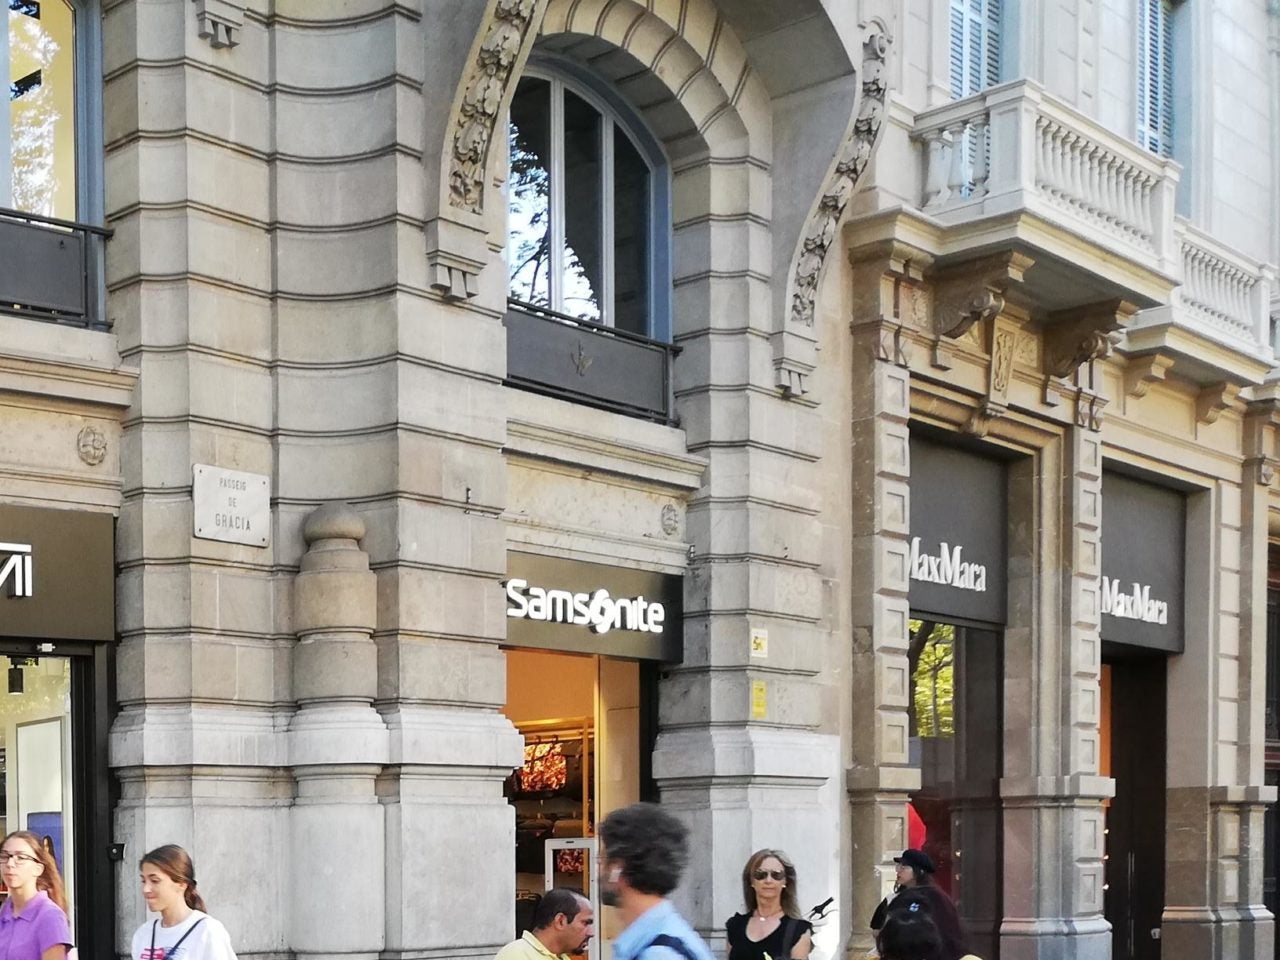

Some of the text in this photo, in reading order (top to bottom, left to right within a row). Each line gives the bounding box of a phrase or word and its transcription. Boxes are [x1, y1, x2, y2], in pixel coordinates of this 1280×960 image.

[219, 477, 247, 491] PASSEIG
[228, 497, 237, 508] DE
[506, 578, 666, 634] Samsonite
[1101, 575, 1168, 625] MaxMara
